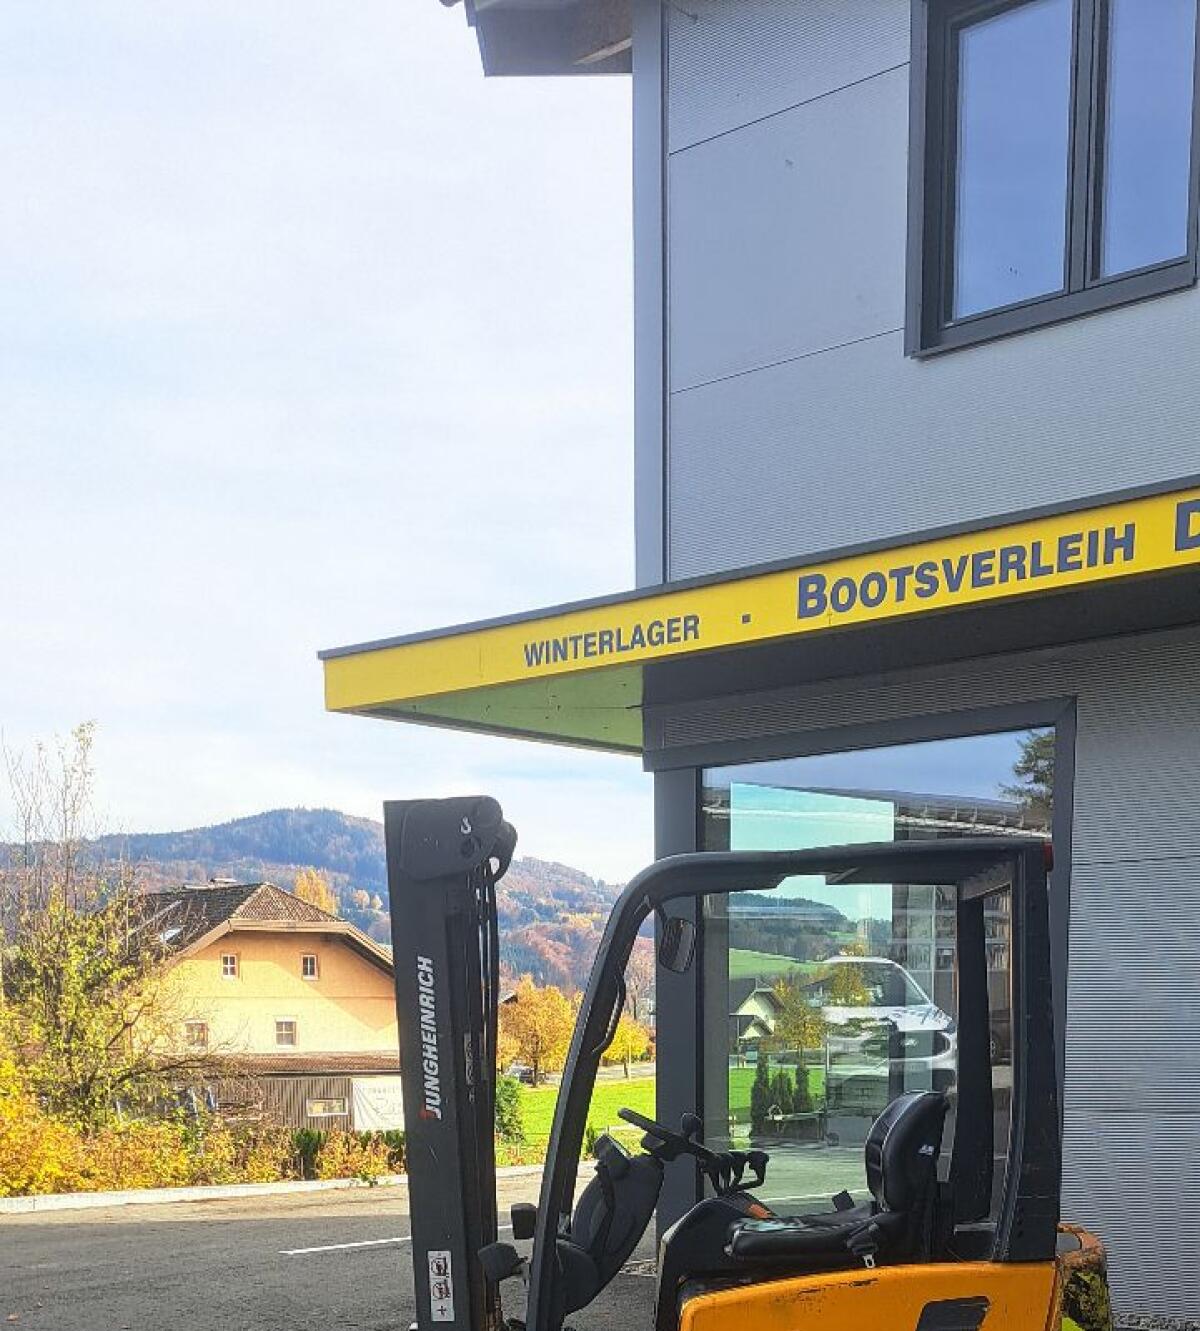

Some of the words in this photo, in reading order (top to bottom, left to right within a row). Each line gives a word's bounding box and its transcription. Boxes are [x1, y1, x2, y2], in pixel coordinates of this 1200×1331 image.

[523, 614, 700, 667] WINTERLAGER
[797, 523, 1136, 619] BOOTSVERLEIH
[417, 956, 442, 1120] JUNGHEINRICH
